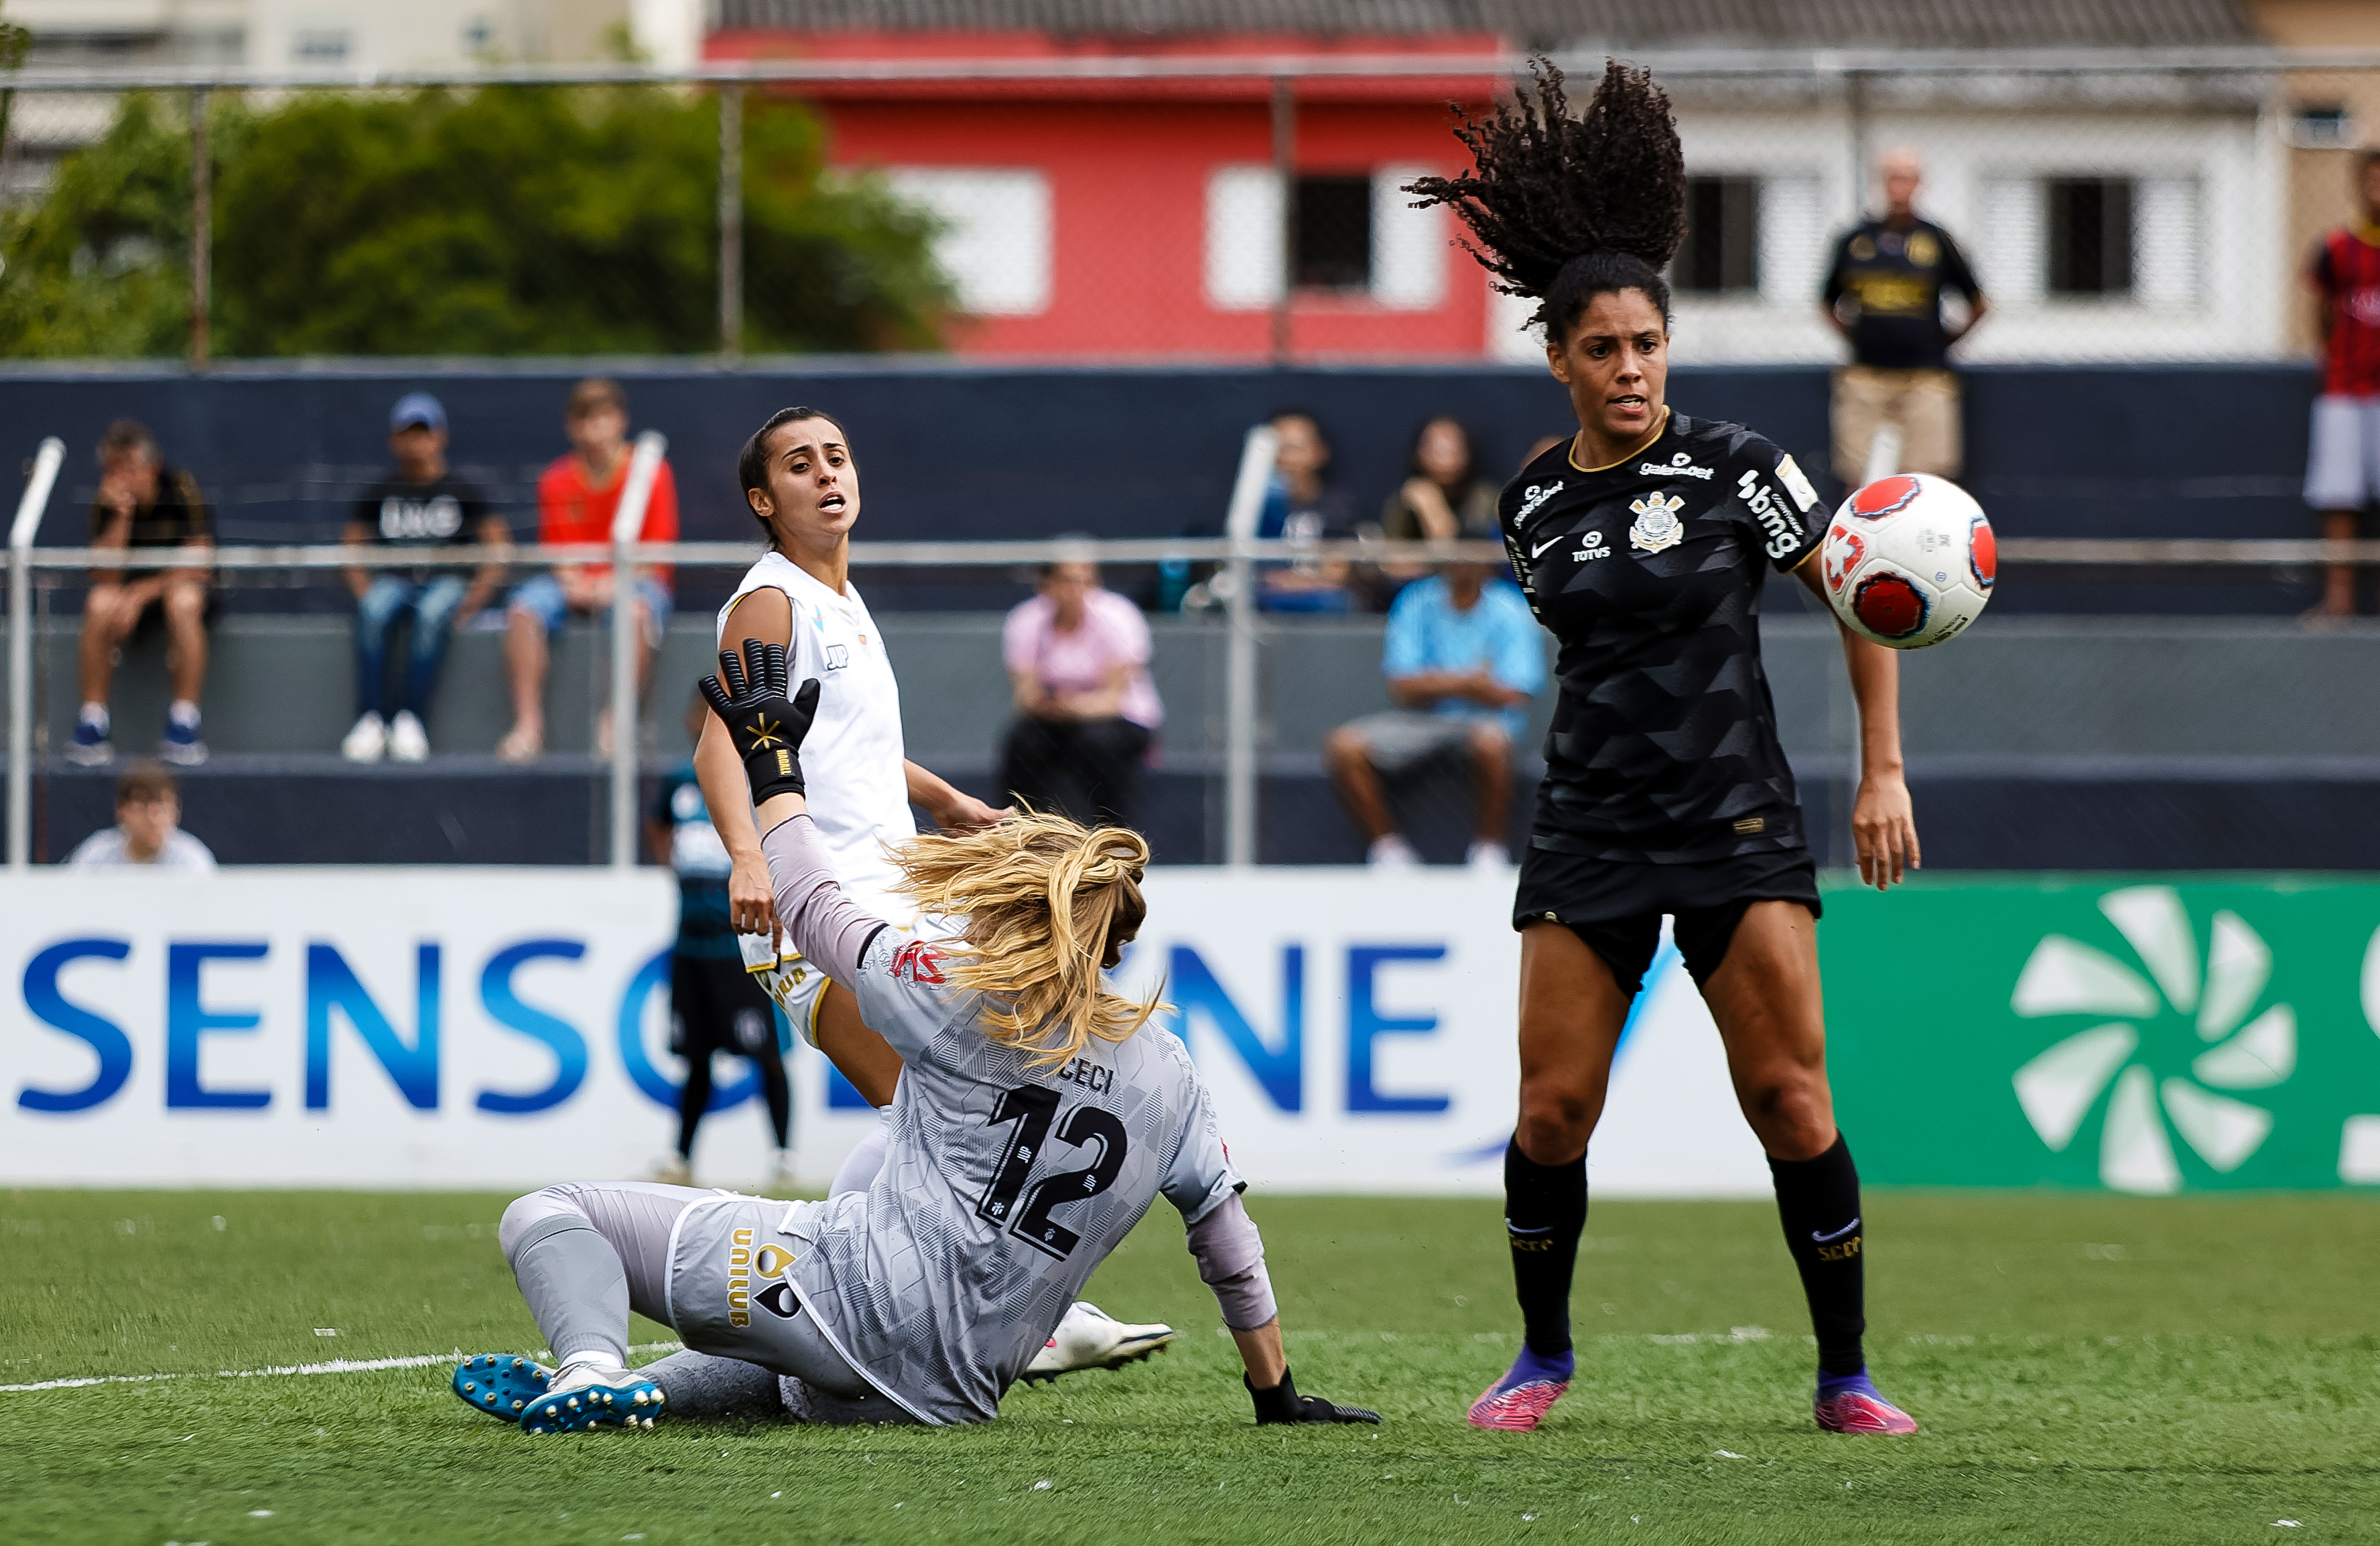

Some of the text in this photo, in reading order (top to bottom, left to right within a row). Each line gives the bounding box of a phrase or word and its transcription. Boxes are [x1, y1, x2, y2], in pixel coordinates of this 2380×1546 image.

[1747, 485, 1801, 559] bmg
[1572, 547, 1611, 561] TOTVS
[826, 644, 848, 671] JUP
[1016, 1145, 1032, 1164] JUP
[975, 1084, 1127, 1262] 12
[1082, 1174, 1097, 1192] JUP
[728, 1228, 753, 1327] UNILUB
